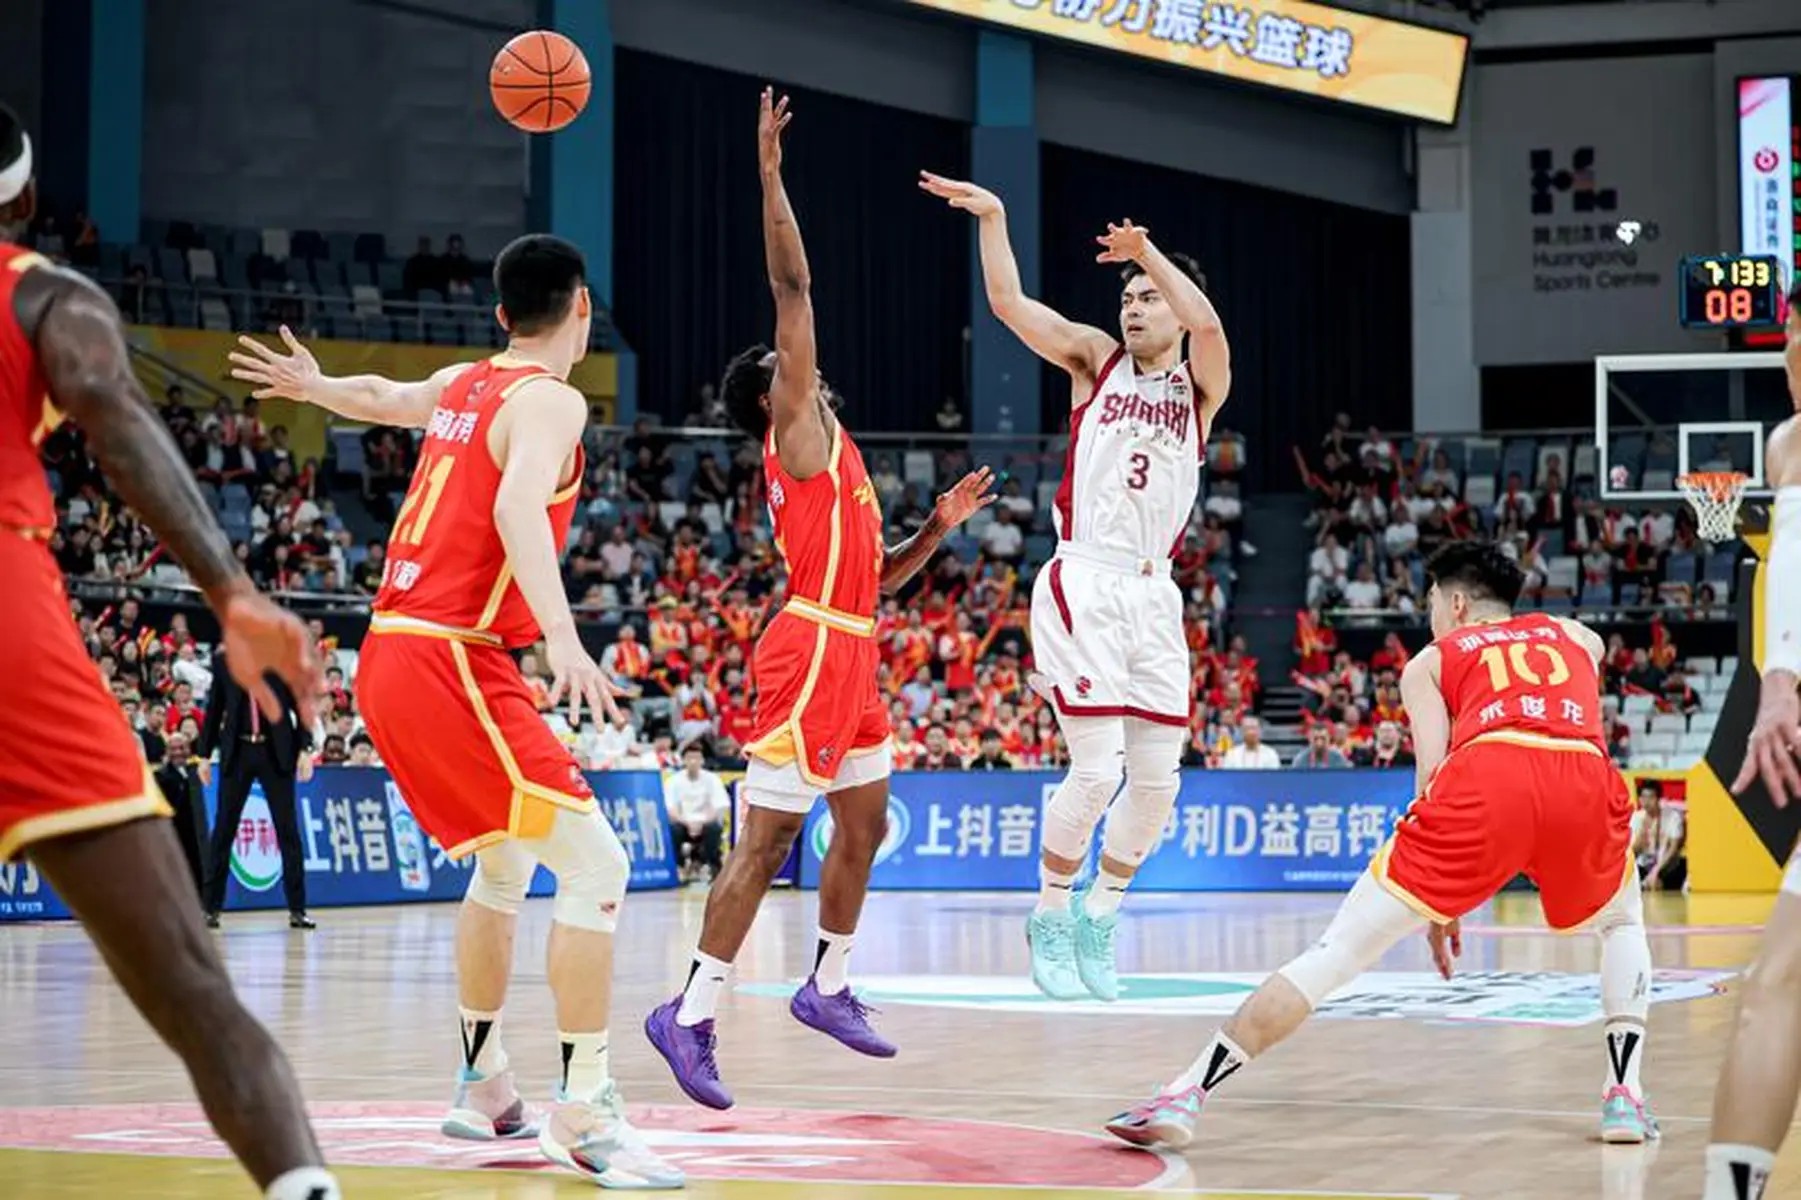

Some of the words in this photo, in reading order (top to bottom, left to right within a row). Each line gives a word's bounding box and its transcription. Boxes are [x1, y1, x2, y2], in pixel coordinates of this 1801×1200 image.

[1010, 0, 1353, 76] 力振兴篮球
[1534, 273, 1591, 293] Sports
[1705, 288, 1752, 324] 08
[1098, 392, 1190, 444] SHANXI
[1126, 452, 1151, 490] 3
[1478, 641, 1571, 693] 10
[303, 797, 391, 875] 上抖音
[914, 803, 1036, 858] 上抖音
[1165, 803, 1398, 858] 利D益高钙
